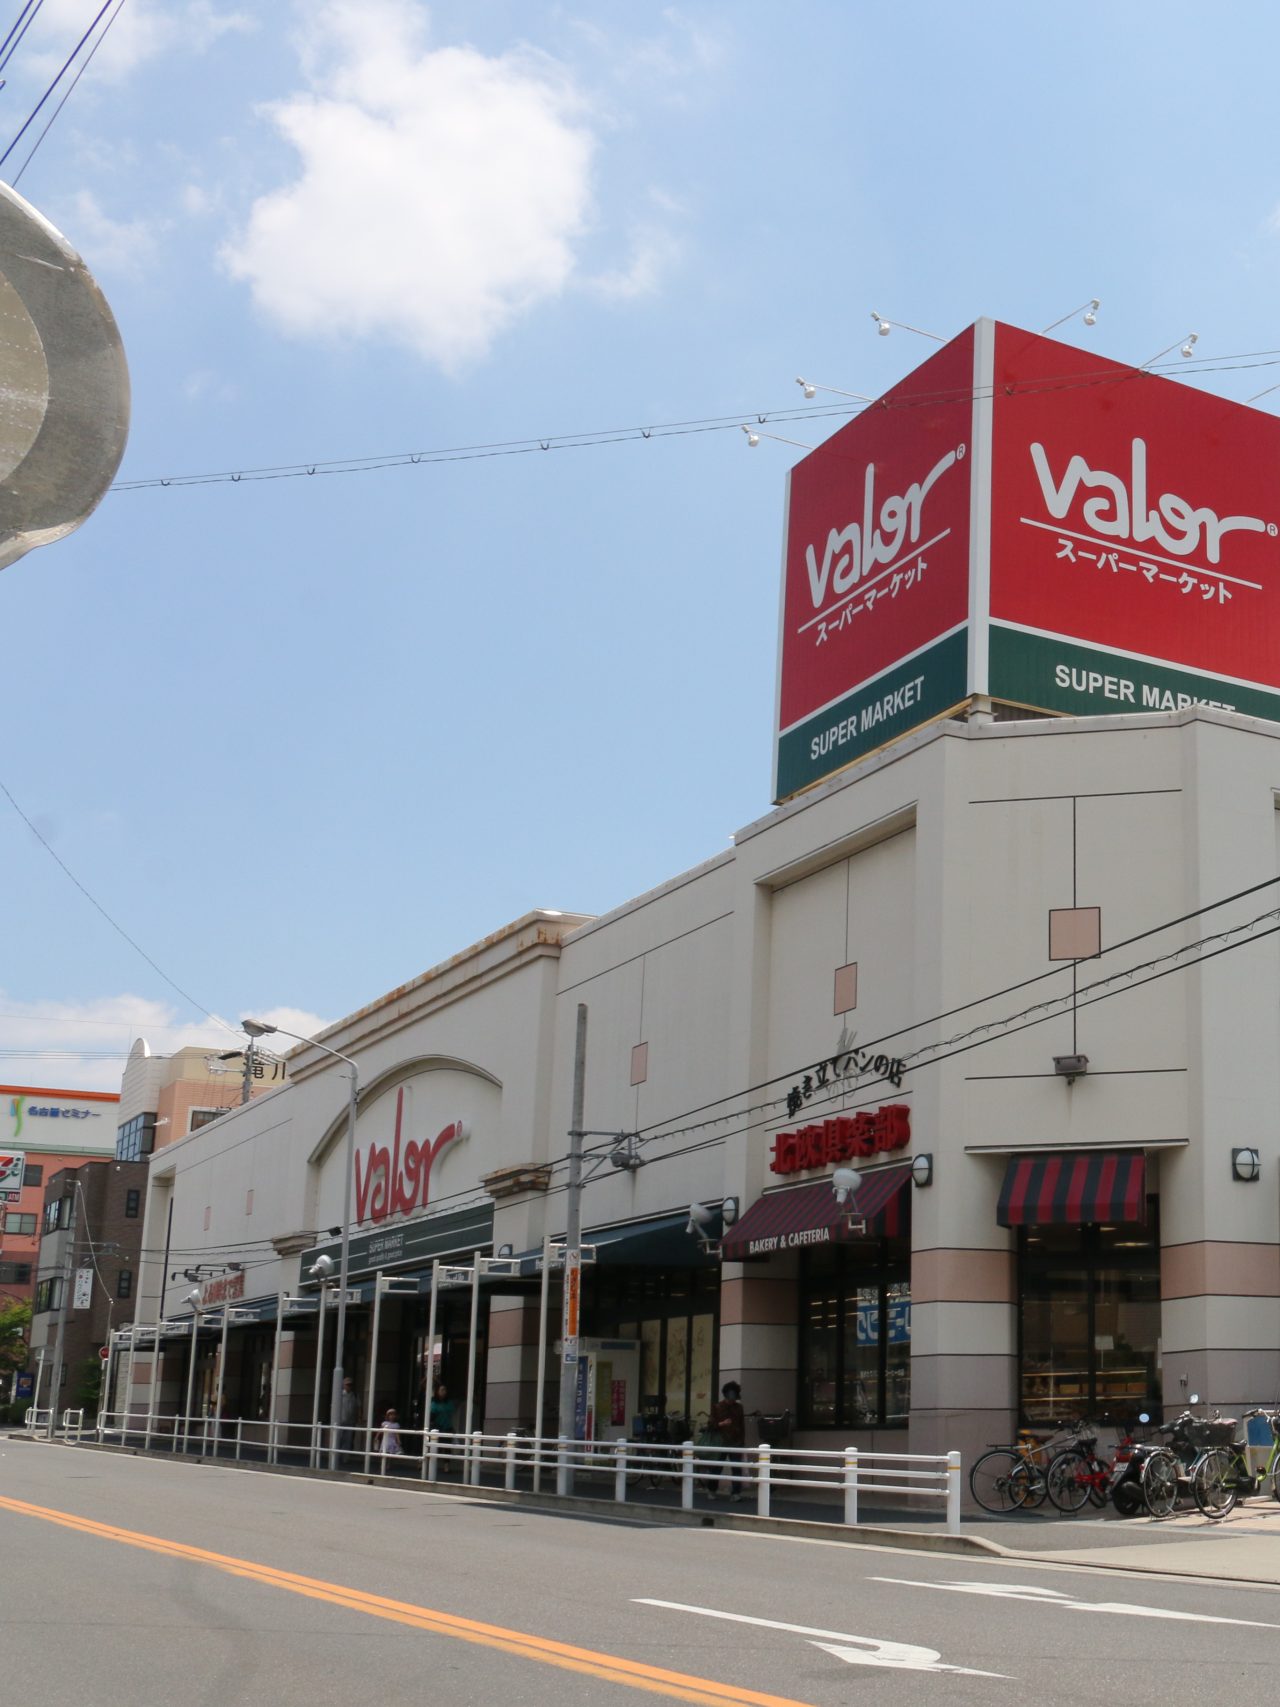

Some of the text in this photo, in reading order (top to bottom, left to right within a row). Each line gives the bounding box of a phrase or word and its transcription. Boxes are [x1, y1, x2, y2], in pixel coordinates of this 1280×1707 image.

[816, 556, 927, 646] スーパーマーケット
[1056, 538, 1232, 604] スーパーマーケット
[811, 675, 924, 760] SUPER MARKET
[1055, 664, 1236, 712] SUPER MAR
[770, 1104, 911, 1175] 北欧倶楽部
[749, 1227, 830, 1254] BAKERY & CAFETERIA
